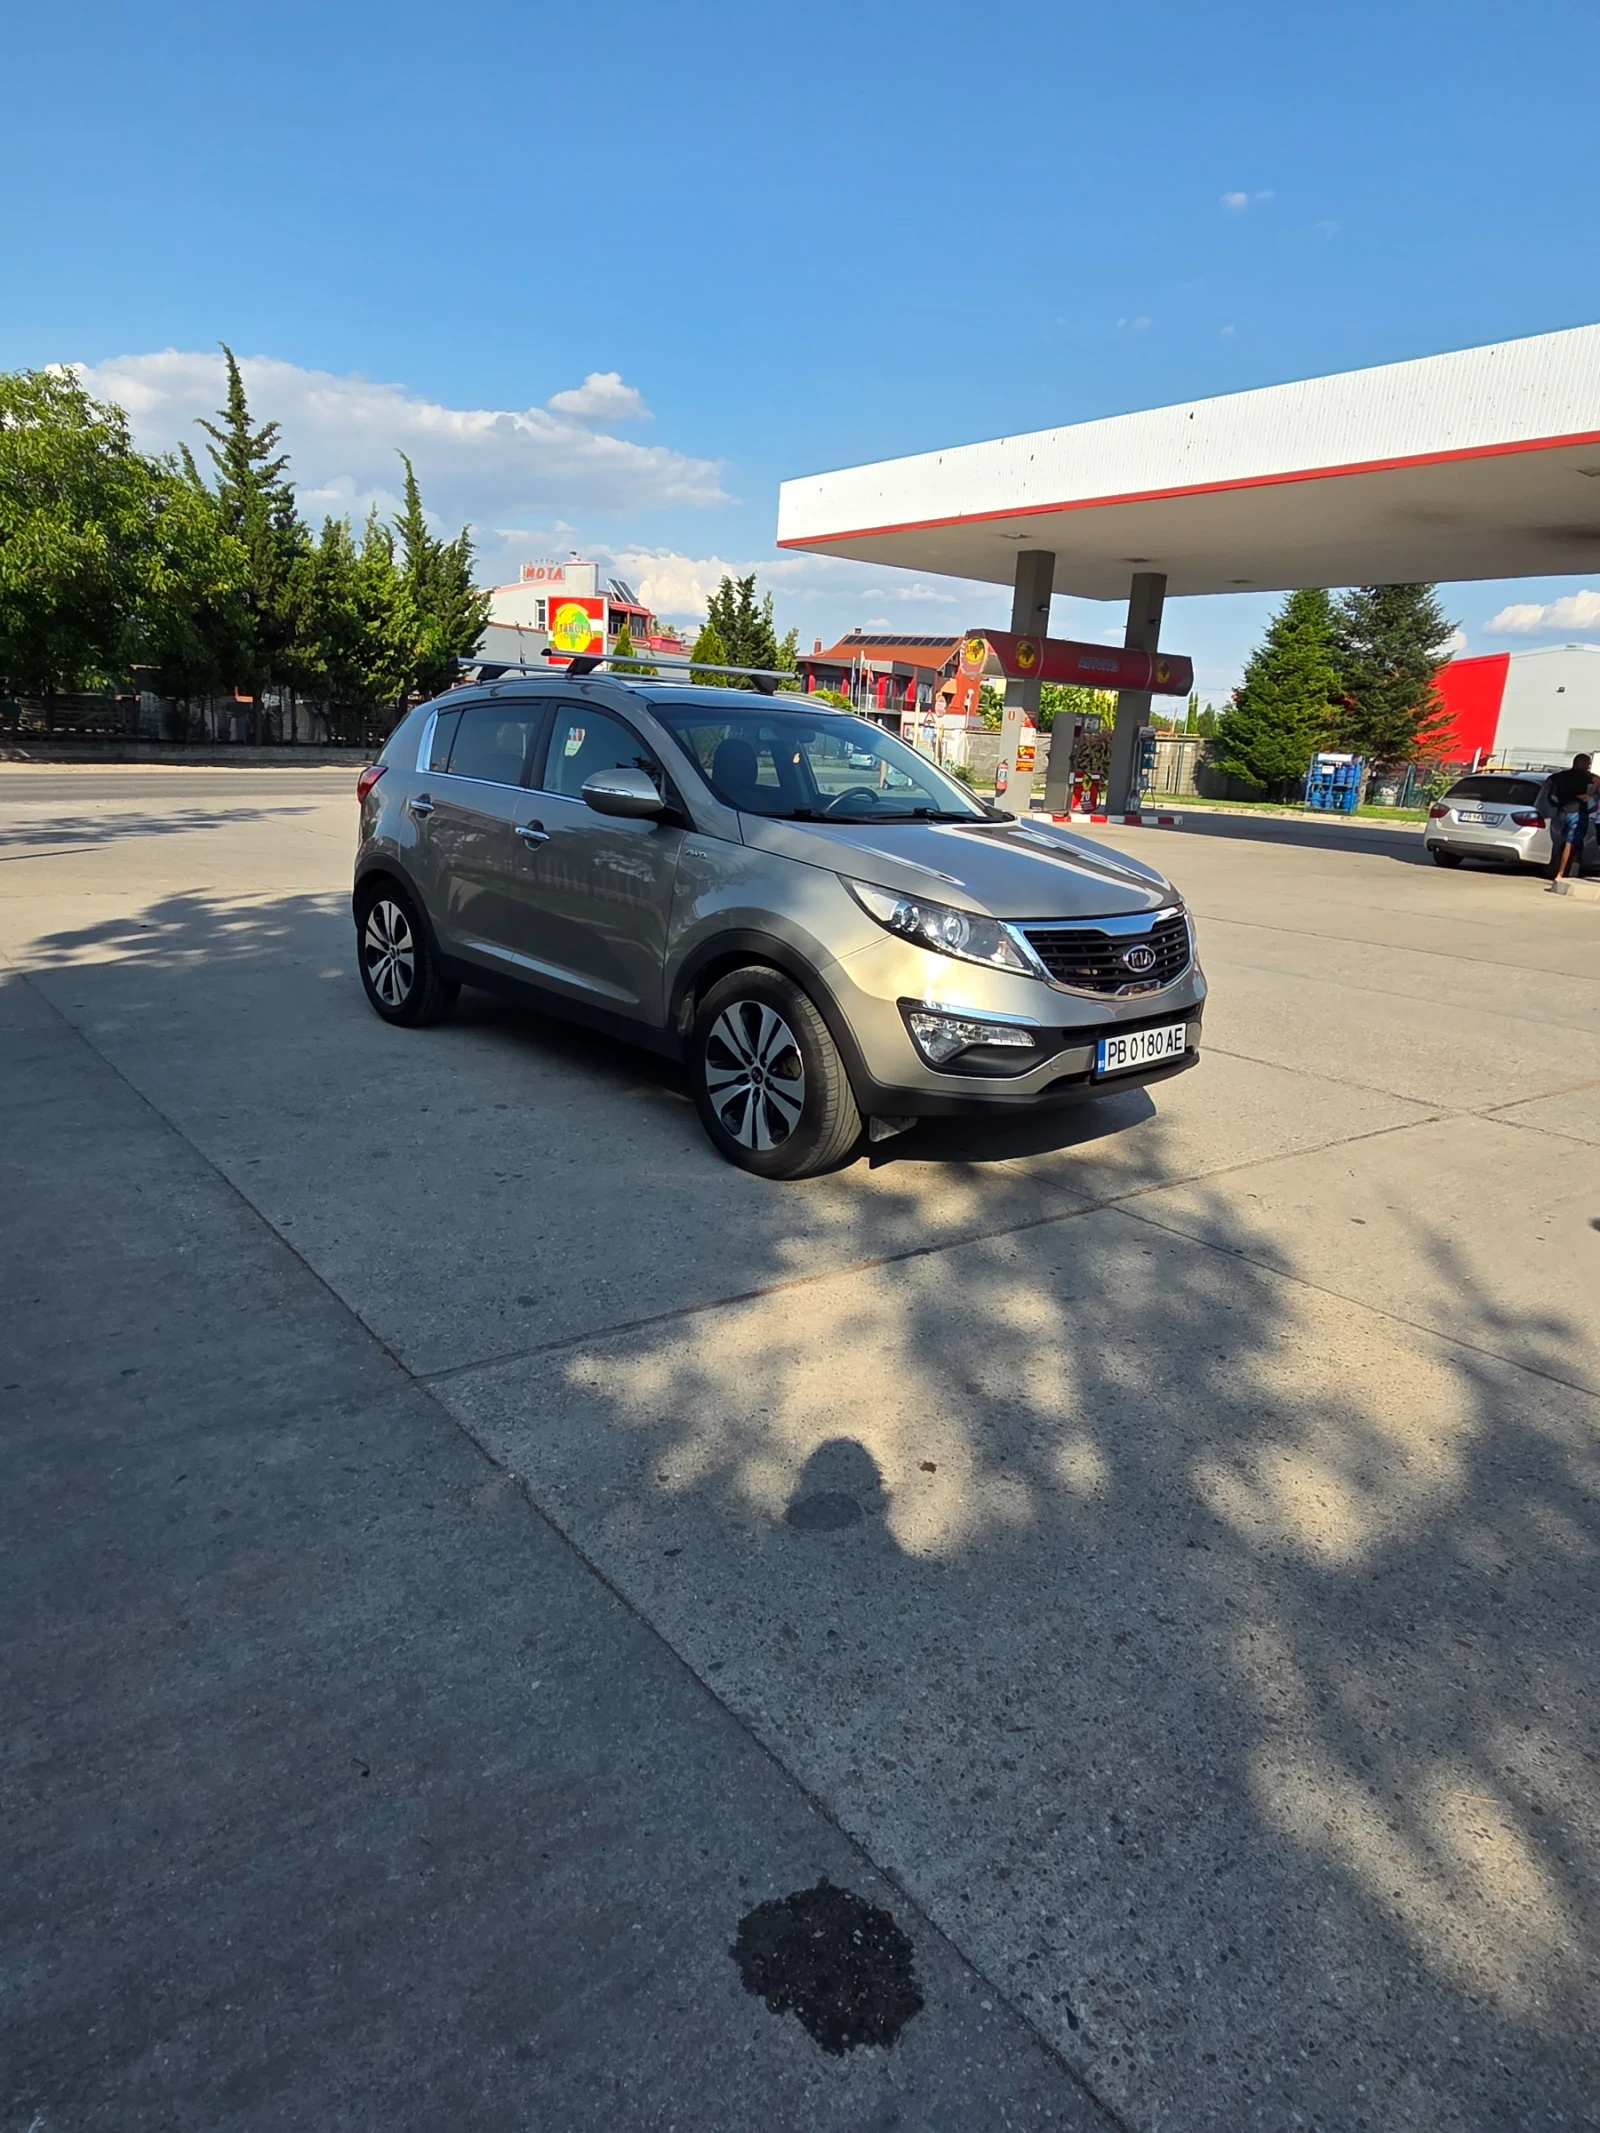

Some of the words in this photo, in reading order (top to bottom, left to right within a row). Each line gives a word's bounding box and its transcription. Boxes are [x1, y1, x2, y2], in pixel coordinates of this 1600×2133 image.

[1080, 790, 1091, 802] 20
[1131, 951, 1152, 968] KIA
[1108, 1040, 1126, 1067] PB
[1130, 1032, 1162, 1060] 0180
[1165, 1028, 1183, 1053] AE
